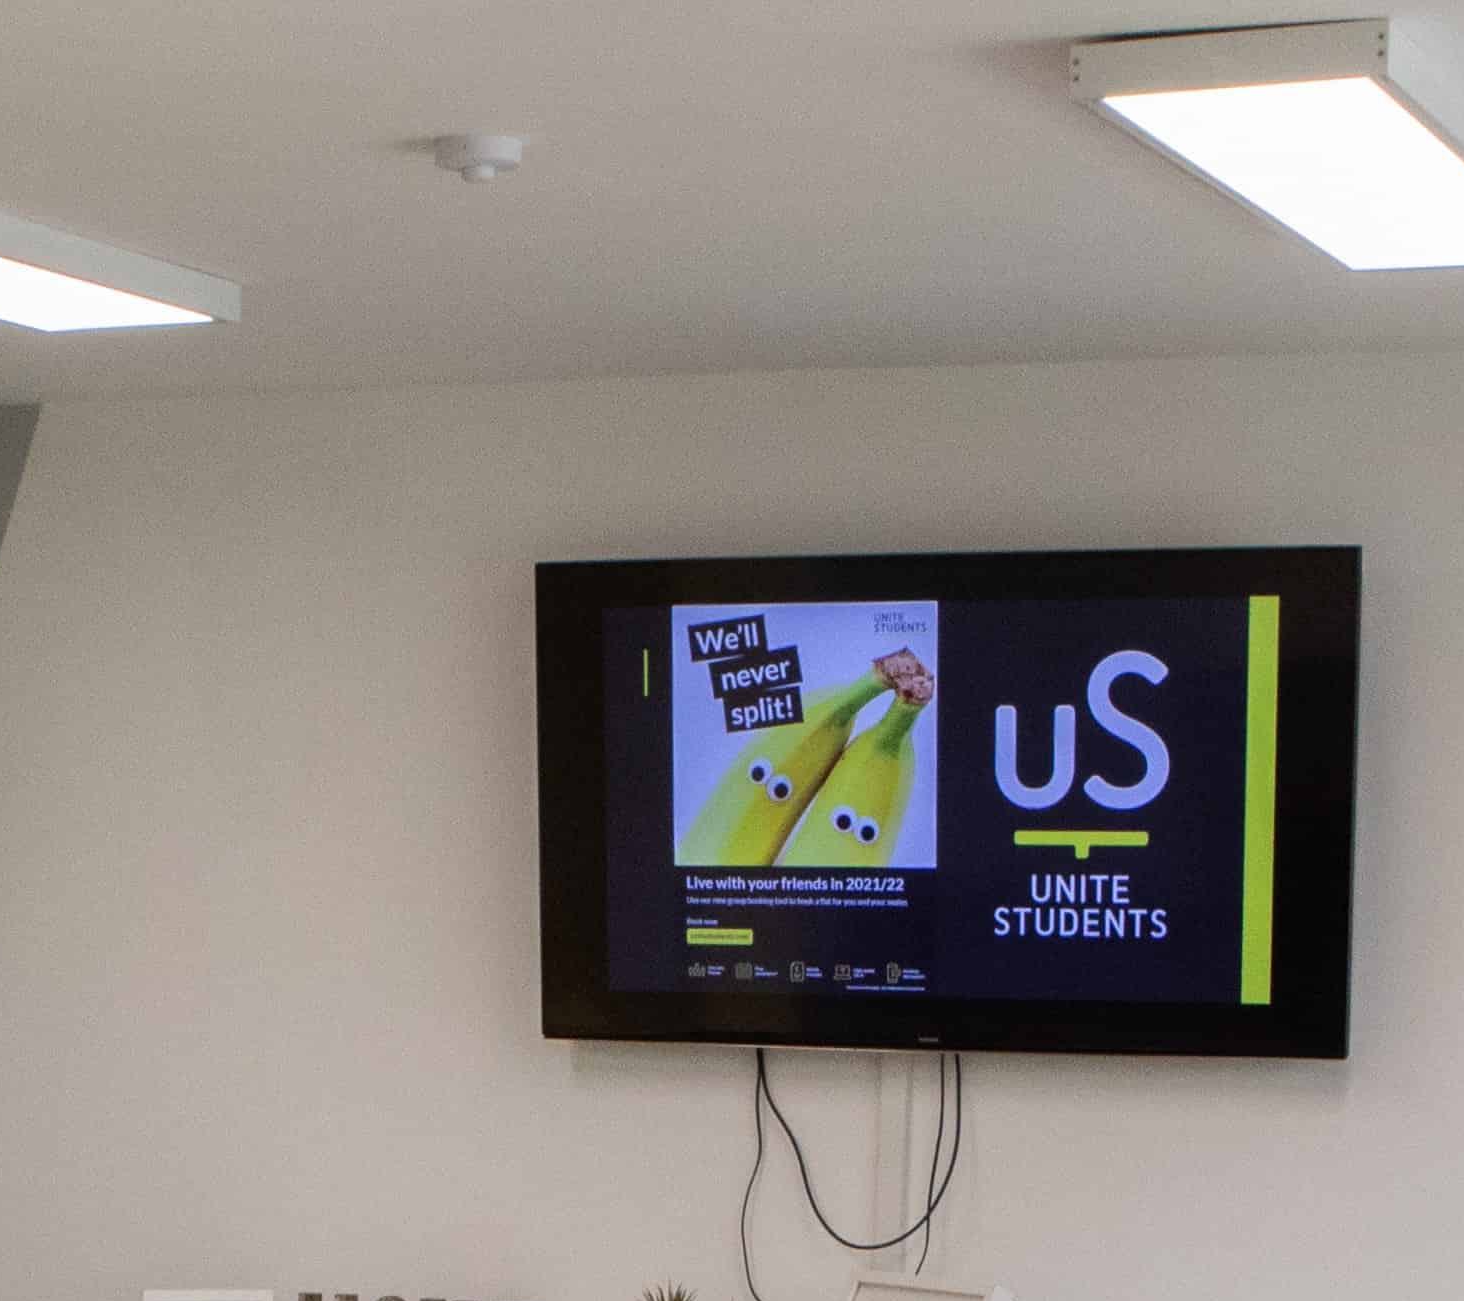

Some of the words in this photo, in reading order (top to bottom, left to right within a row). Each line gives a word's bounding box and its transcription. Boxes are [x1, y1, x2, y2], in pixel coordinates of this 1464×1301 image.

[873, 622, 927, 633] STUDENTS
[874, 612, 905, 623] UNITE
[695, 622, 759, 655] We'll
[721, 660, 792, 691] never
[731, 694, 795, 729] split!
[686, 875, 714, 890] Live
[715, 876, 746, 890] with
[746, 879, 779, 893] your
[780, 876, 828, 891] friends
[830, 877, 844, 891] in
[846, 877, 905, 892] 2021/22
[1030, 873, 1130, 904] UNITE
[993, 906, 1169, 939] STUDENTS
